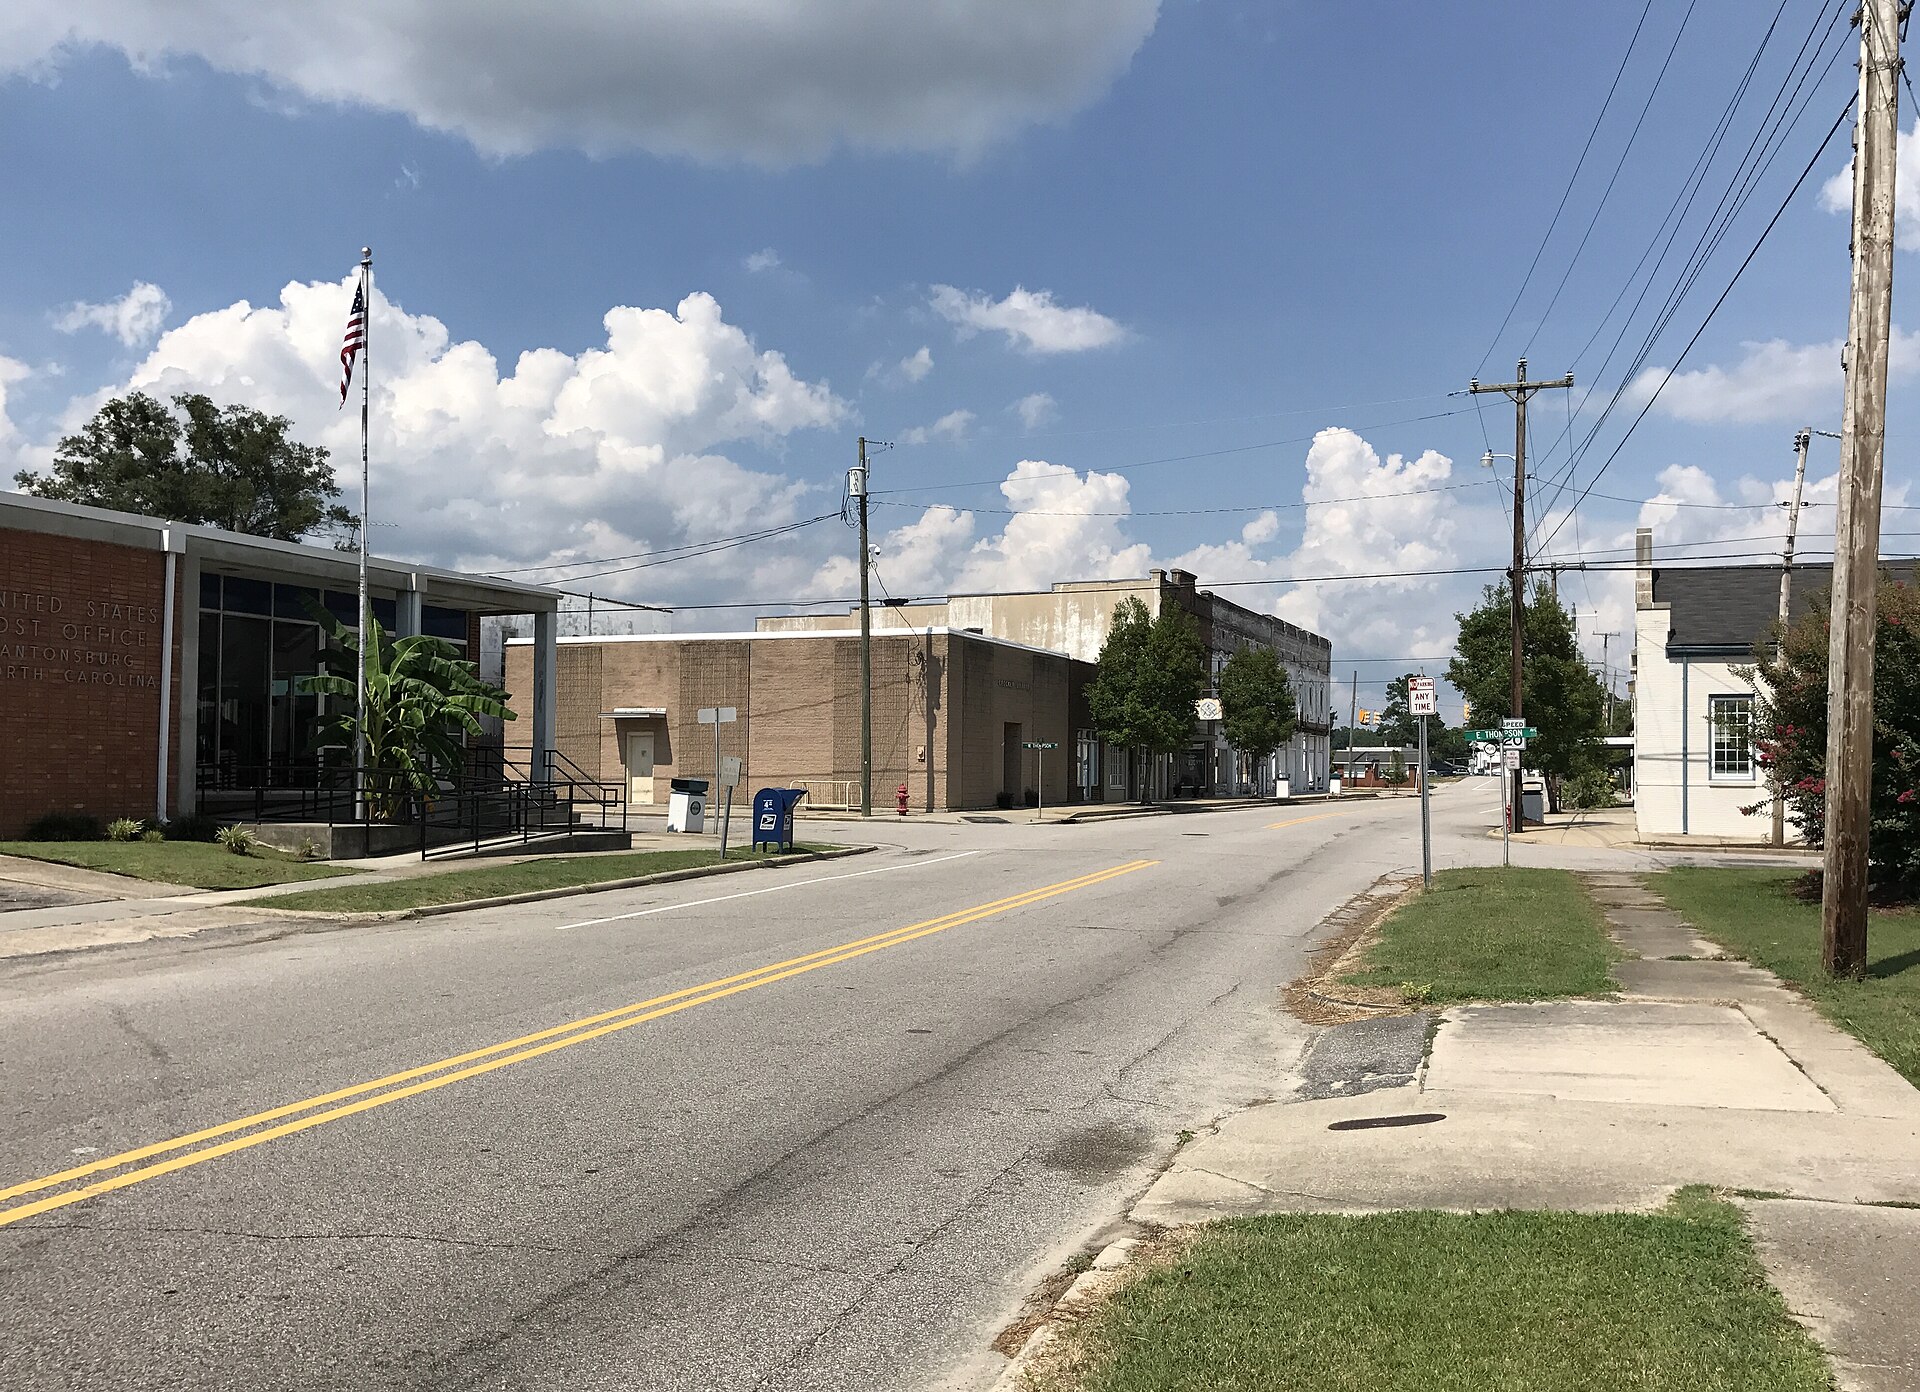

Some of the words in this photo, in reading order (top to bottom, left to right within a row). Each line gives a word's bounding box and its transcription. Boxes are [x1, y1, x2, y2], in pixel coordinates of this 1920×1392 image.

[87, 600, 158, 624] STATES
[63, 623, 147, 647] OFFICE
[0, 644, 134, 667] ANTONSBURG
[0, 665, 43, 680] RTH
[64, 669, 156, 688] CAROLINA
